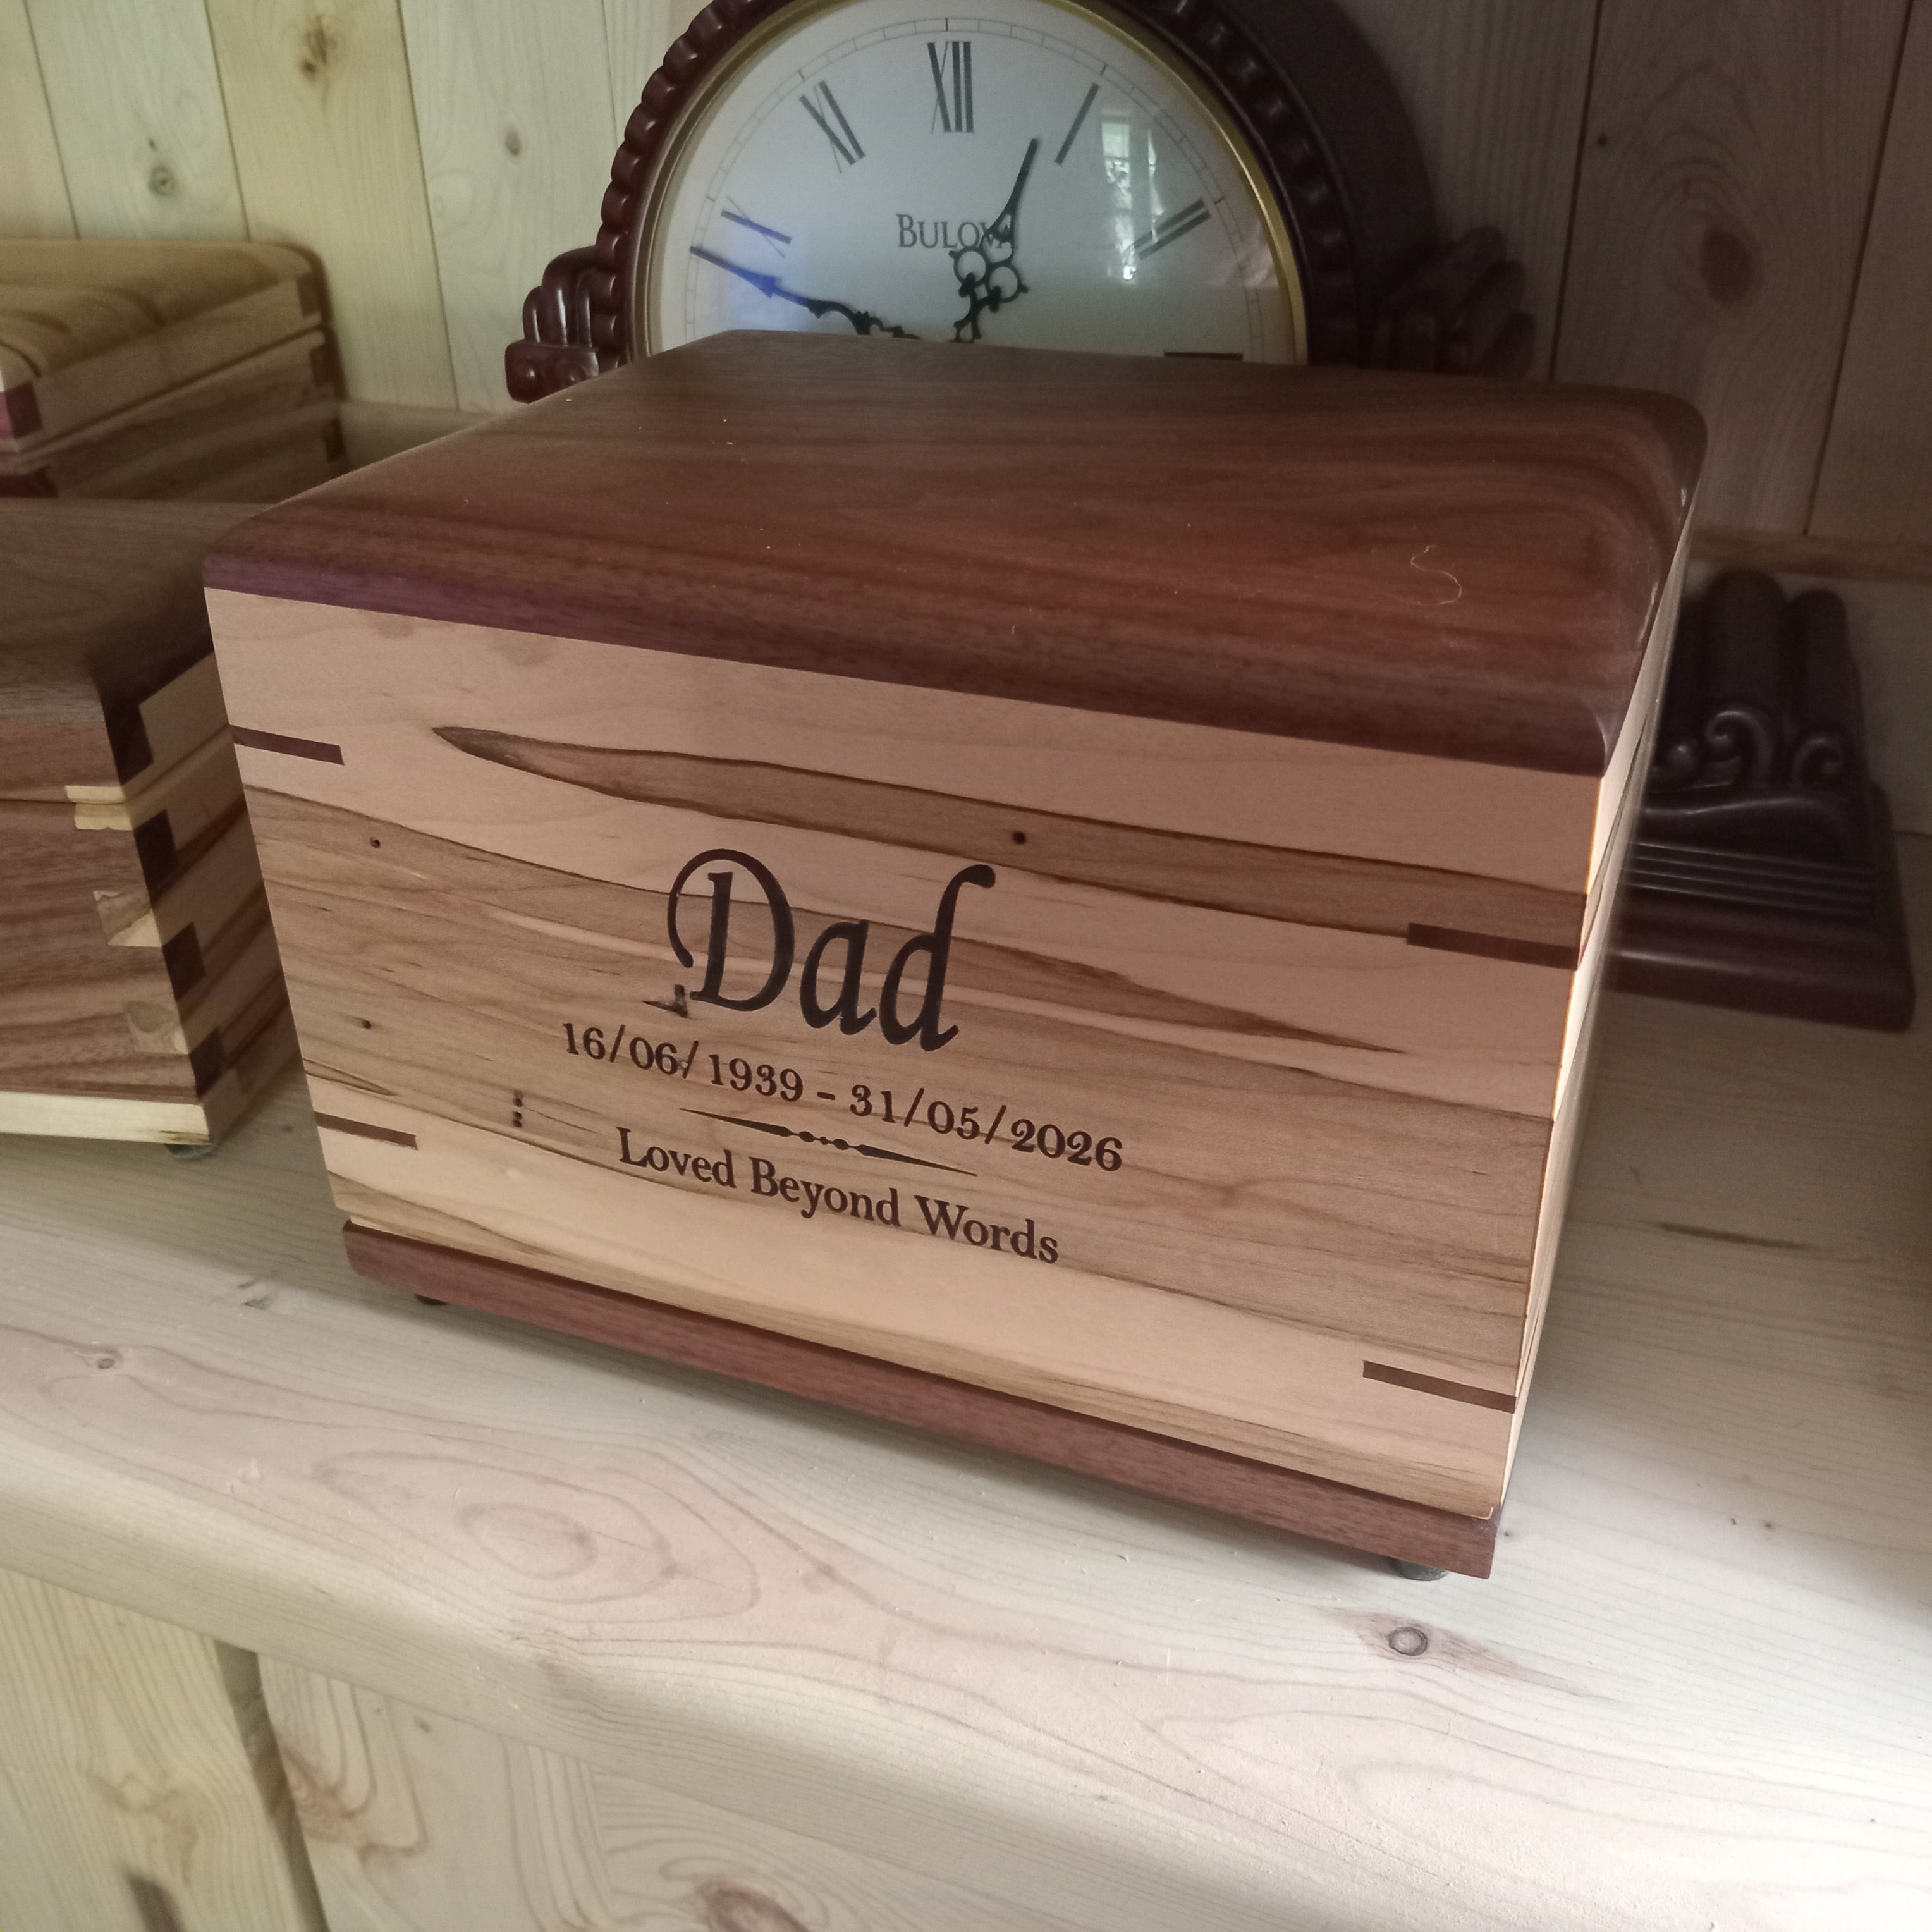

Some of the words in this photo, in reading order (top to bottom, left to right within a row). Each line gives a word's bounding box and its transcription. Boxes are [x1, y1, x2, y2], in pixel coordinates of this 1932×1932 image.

[798, 80, 865, 174] XI
[926, 40, 975, 135] XII
[667, 848, 996, 1052] Dad
[562, 1022, 804, 1103] 16/06/1939
[849, 1084, 1123, 1171] 31/05/2026
[615, 1126, 737, 1189] Loved
[748, 1156, 902, 1227] Beyond
[913, 1194, 1059, 1264] Words
